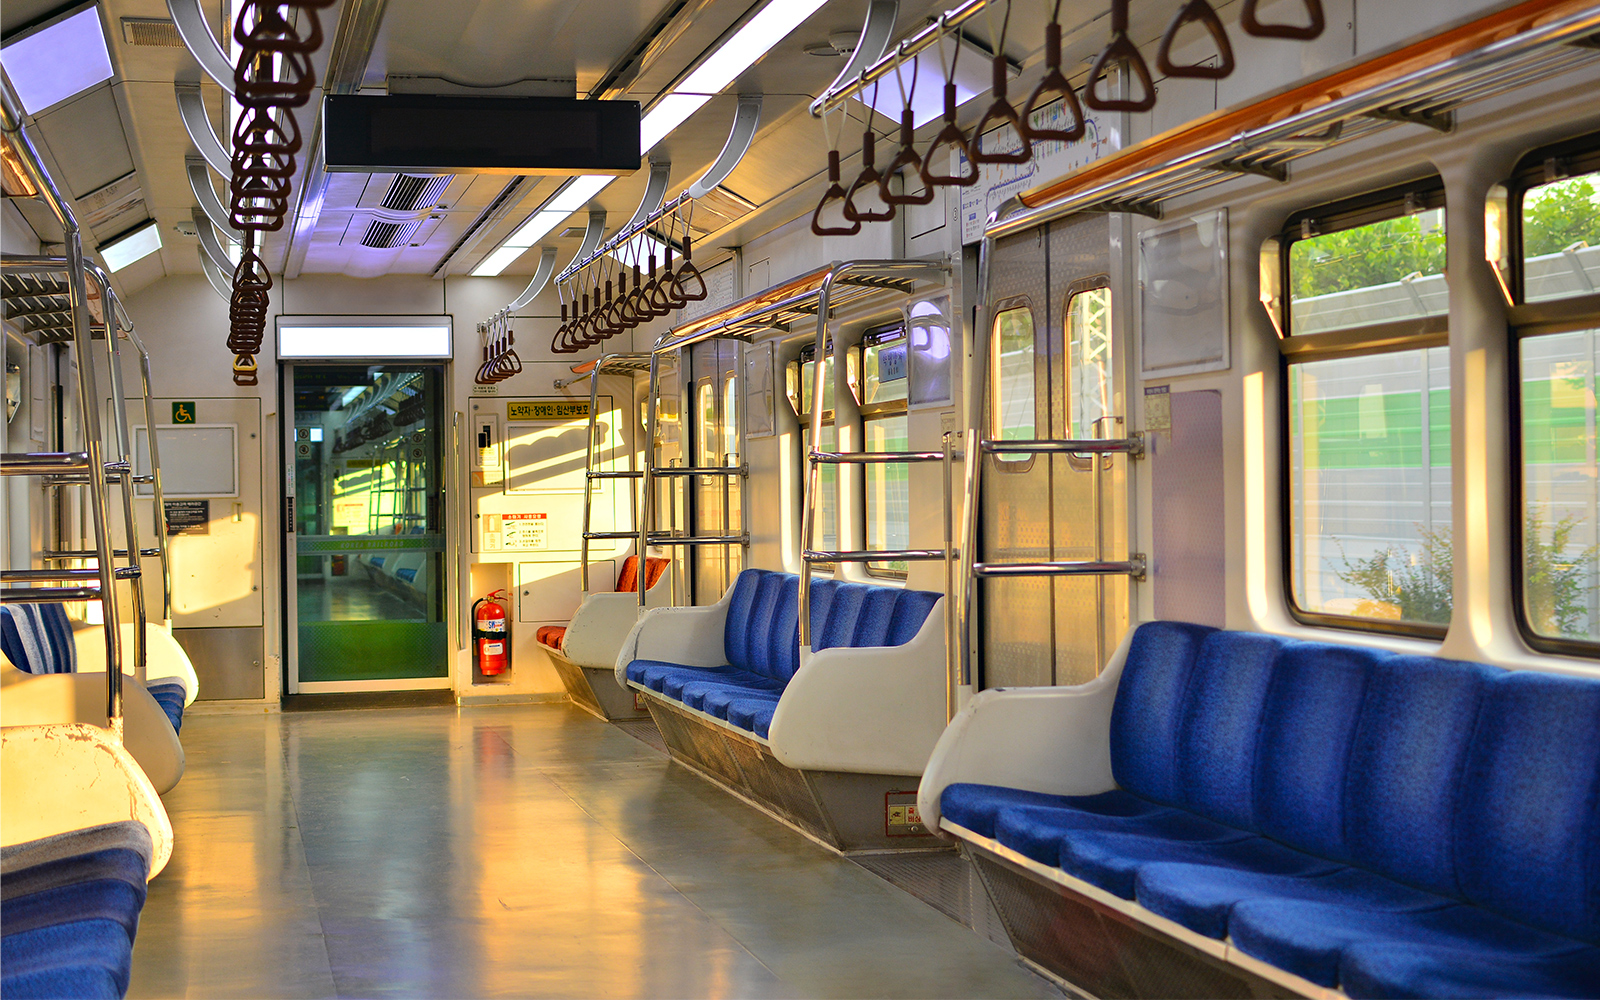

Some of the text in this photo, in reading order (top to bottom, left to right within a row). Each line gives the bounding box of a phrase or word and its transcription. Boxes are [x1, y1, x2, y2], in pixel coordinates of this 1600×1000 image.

[511, 404, 589, 416] 노약자·장애인·임산부보호
[341, 540, 404, 549] KOREA RAILROAD
[908, 815, 922, 823] 비상
